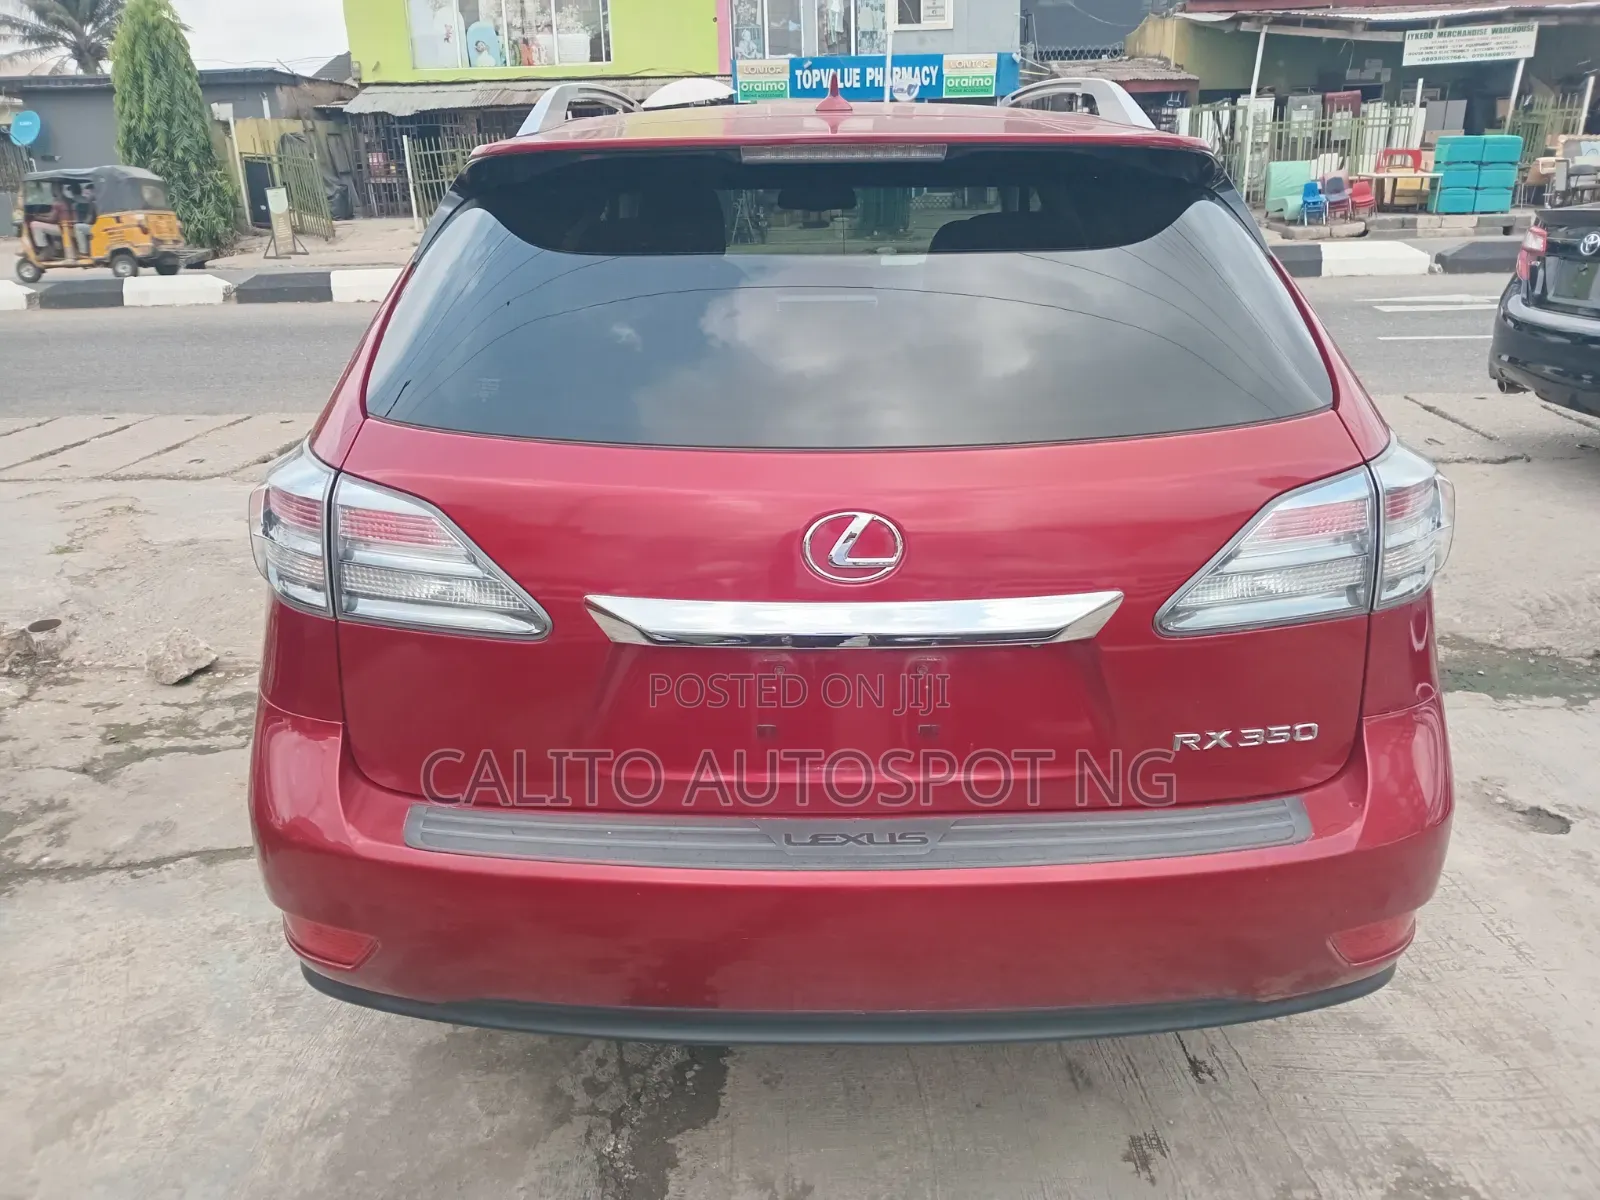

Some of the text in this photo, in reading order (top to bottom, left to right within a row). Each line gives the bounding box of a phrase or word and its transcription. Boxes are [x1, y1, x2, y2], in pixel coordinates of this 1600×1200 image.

[1406, 31, 1434, 41] IYKEDO
[1436, 28, 1488, 39] MERCHANDISE
[1491, 24, 1536, 35] WAREHOUSE
[866, 65, 939, 88] PHRMACY
[946, 75, 992, 88] oraimo
[741, 80, 786, 92] oraimo
[1172, 722, 1319, 751] RX 350
[784, 832, 930, 847] LEXUS
